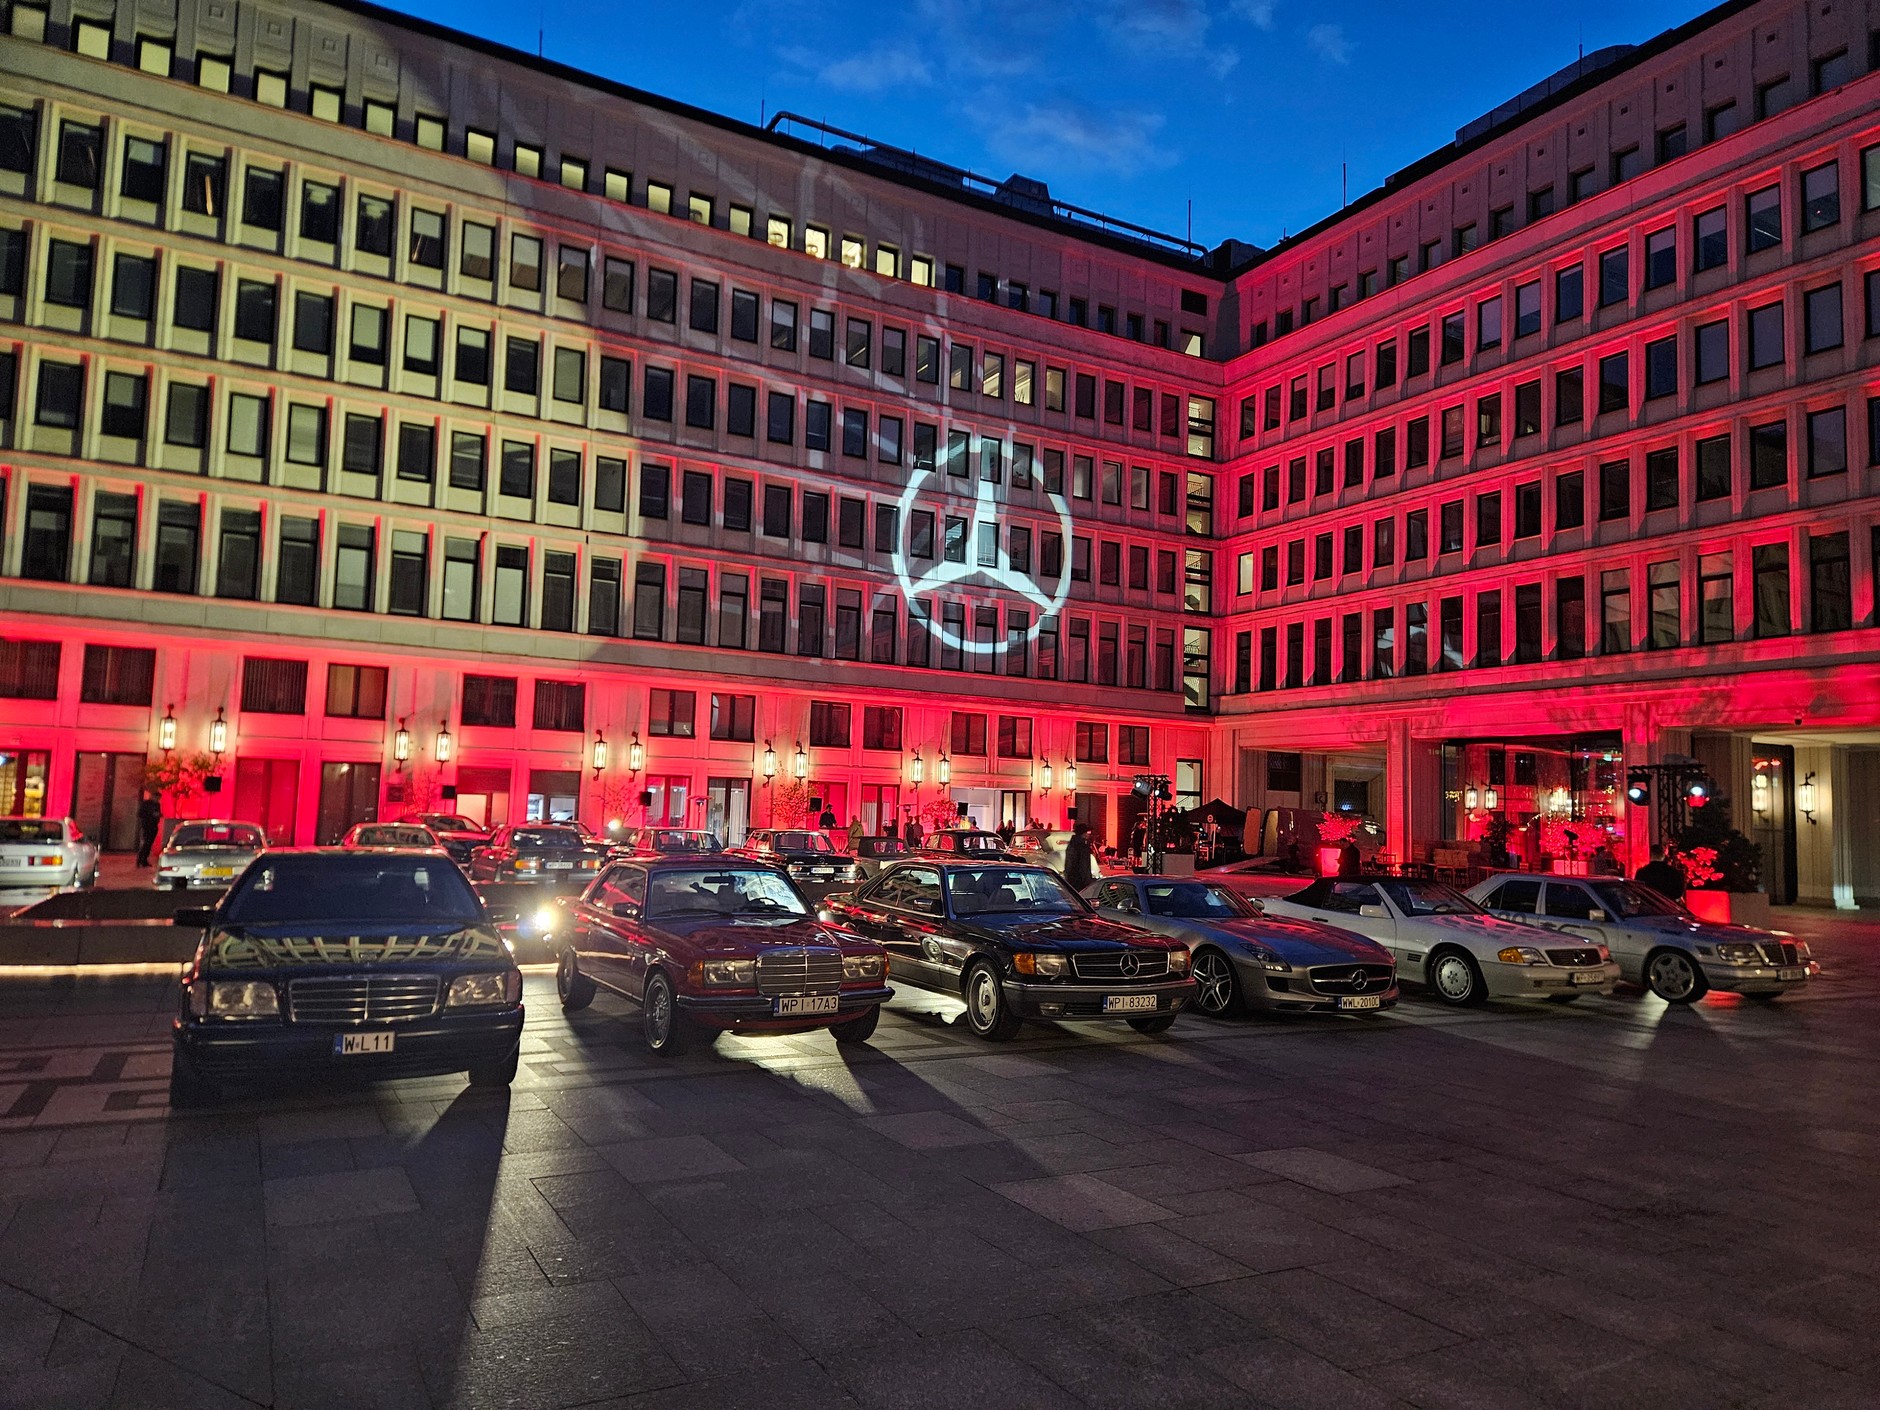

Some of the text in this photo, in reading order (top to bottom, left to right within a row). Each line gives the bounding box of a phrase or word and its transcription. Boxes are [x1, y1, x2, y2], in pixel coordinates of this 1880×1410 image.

[781, 998, 804, 1012] WPI
[1108, 996, 1156, 1009] WPI 83232
